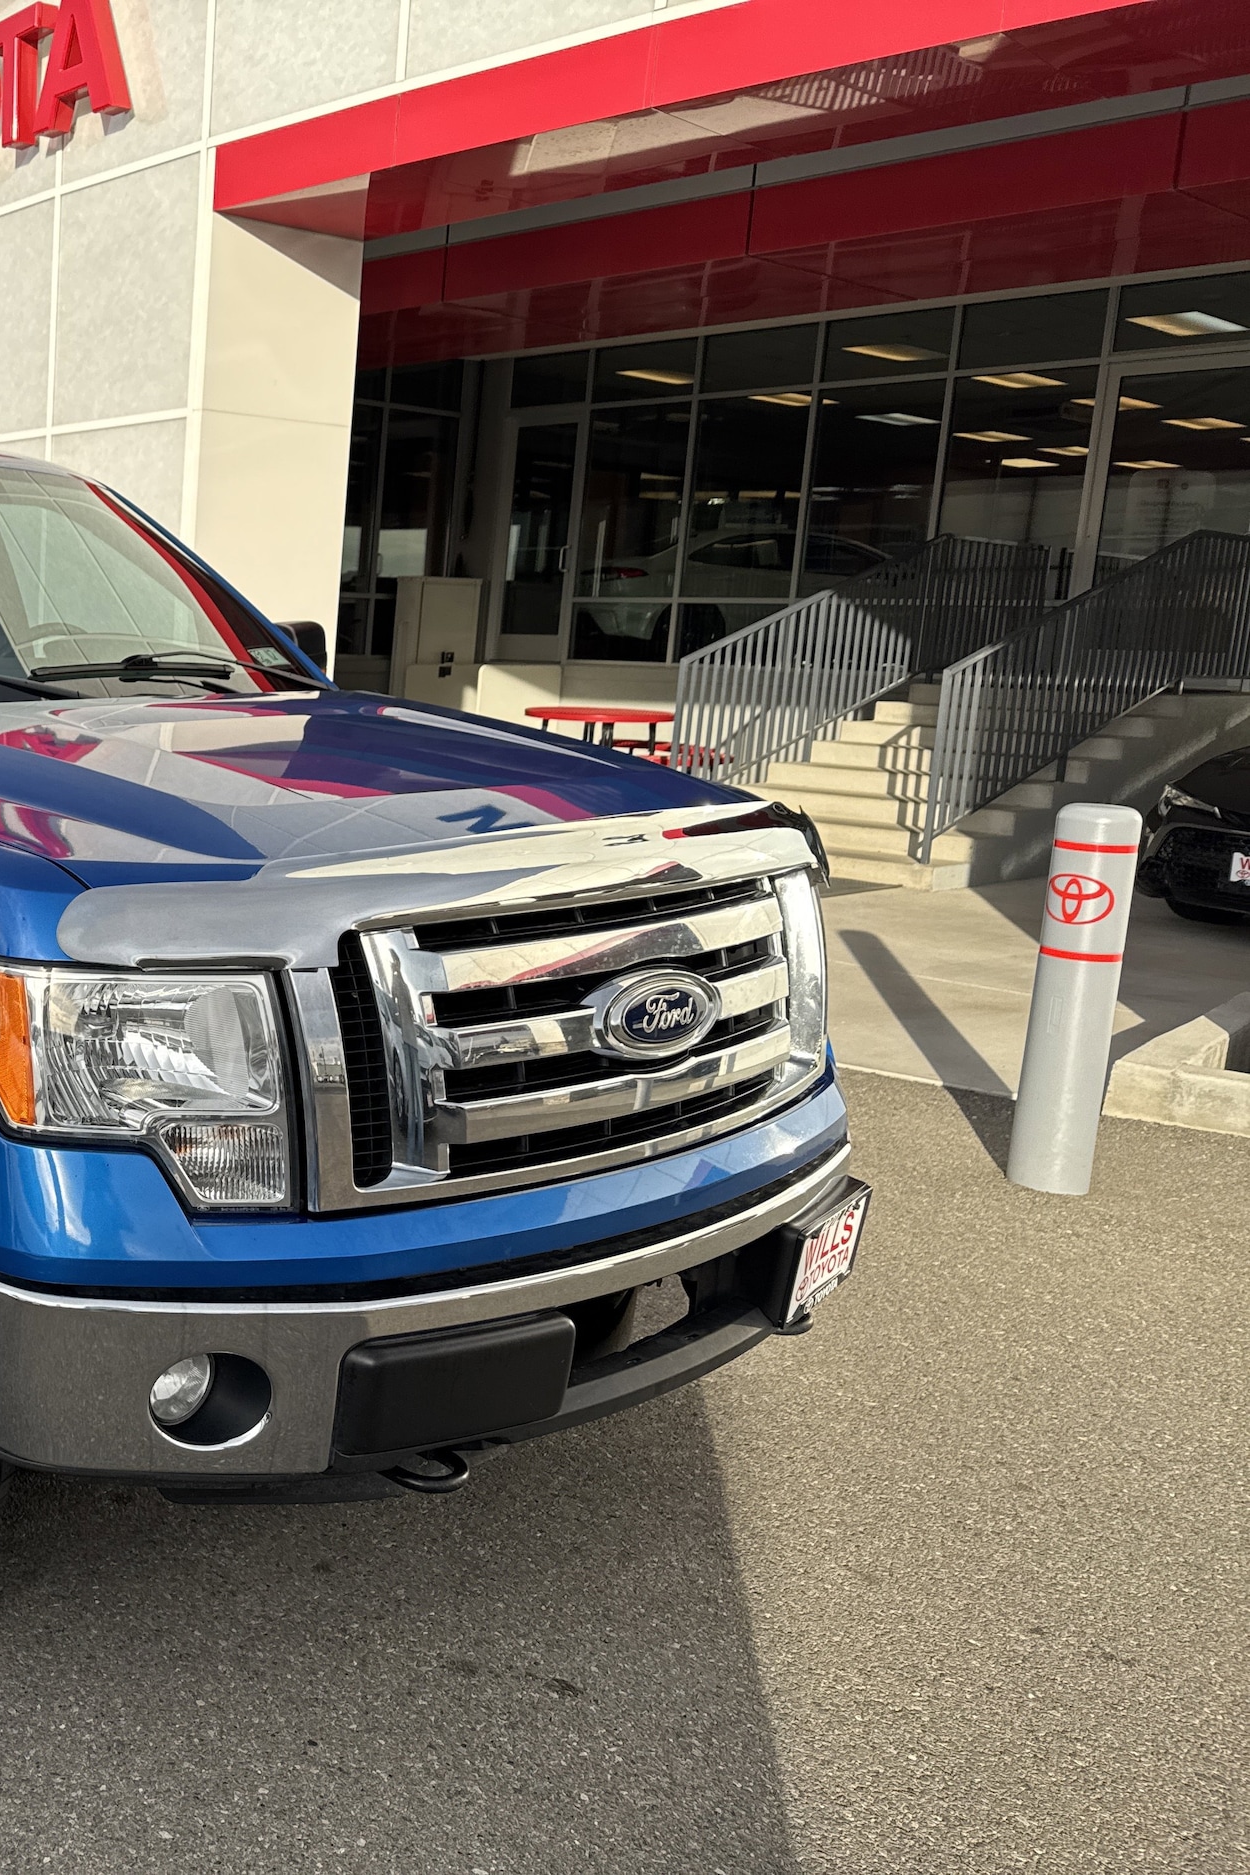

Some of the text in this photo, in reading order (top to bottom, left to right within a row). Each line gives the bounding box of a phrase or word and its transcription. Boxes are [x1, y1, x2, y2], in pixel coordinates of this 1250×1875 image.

[641, 991, 695, 1033] Ford
[804, 1211, 854, 1276] WILLS
[809, 1246, 849, 1290] TOYOTA
